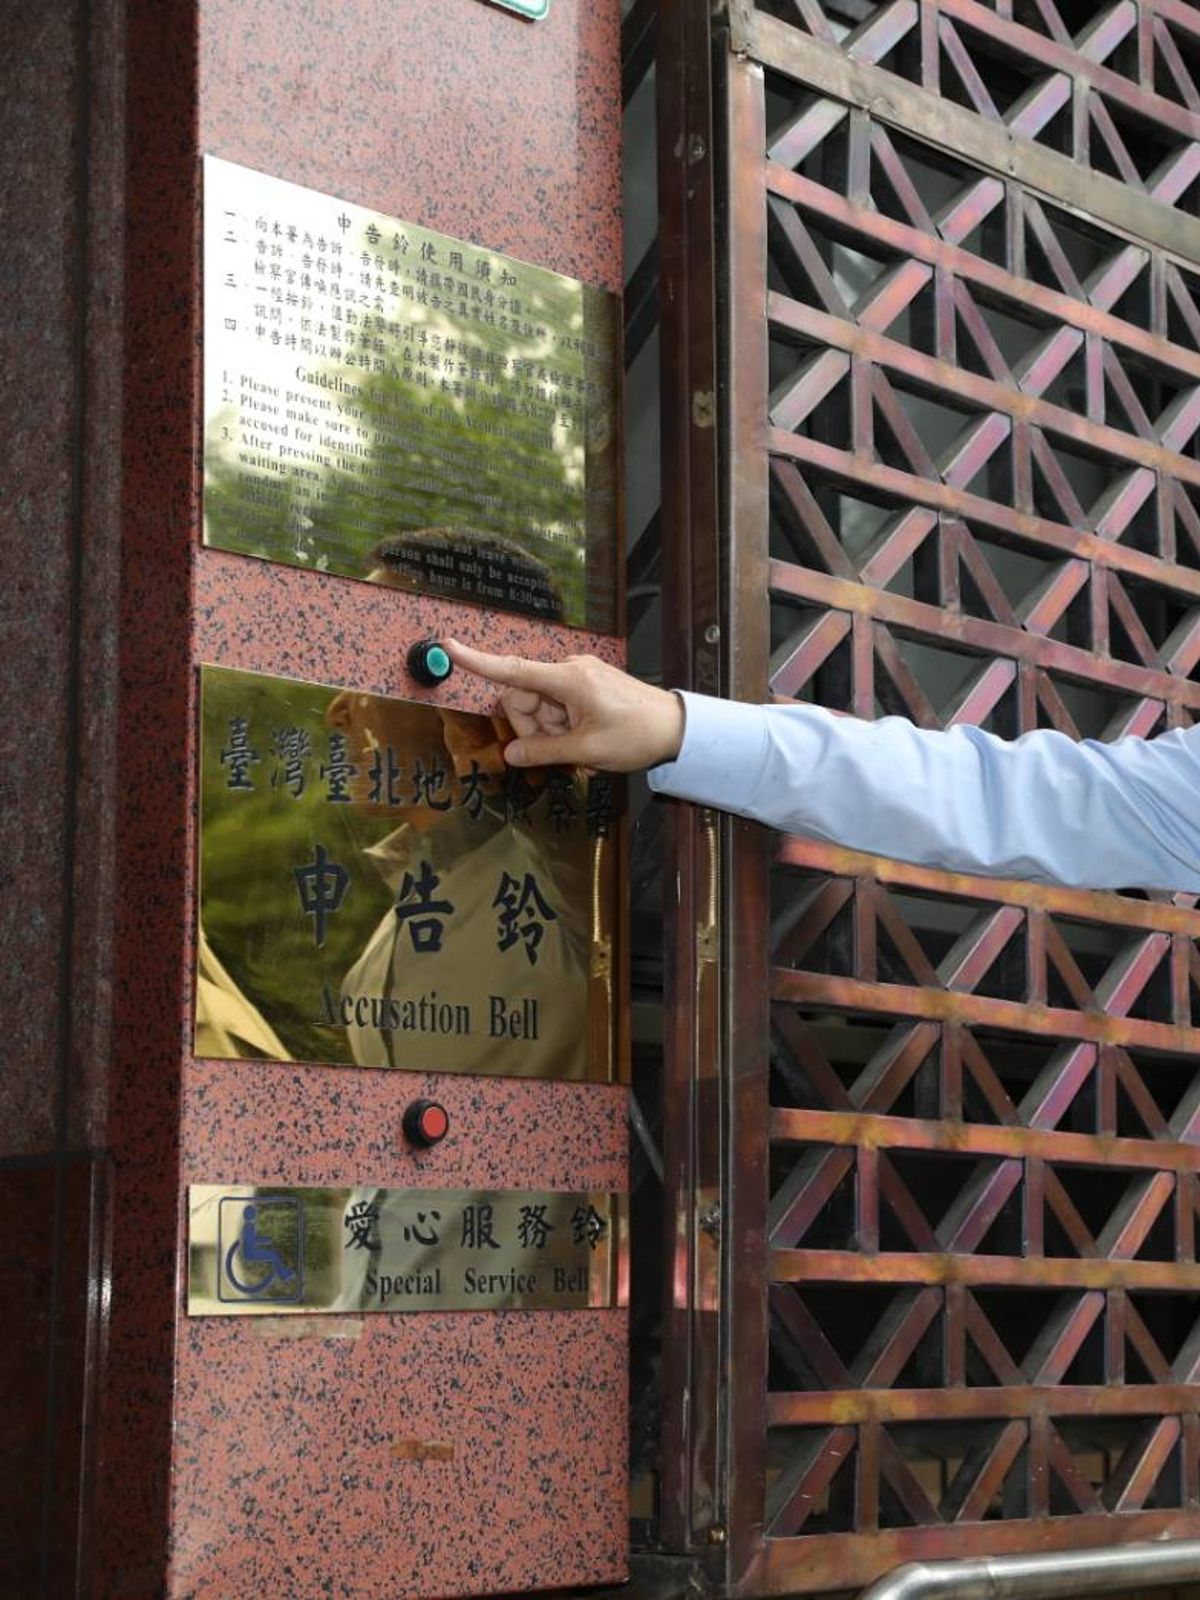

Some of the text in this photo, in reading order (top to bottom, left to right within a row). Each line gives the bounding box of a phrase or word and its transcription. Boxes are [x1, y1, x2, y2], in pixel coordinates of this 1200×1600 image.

[337, 211, 517, 292] 申告鈴使用須知
[221, 370, 233, 386] 1.
[239, 375, 279, 398] Please
[286, 388, 331, 414] present
[337, 401, 364, 423] your
[295, 365, 364, 398] Guidelines
[221, 388, 233, 404] 2.
[239, 393, 279, 416] Please
[286, 405, 319, 426] make
[324, 418, 350, 435] sure
[356, 424, 369, 439] to
[239, 411, 288, 437] accused
[294, 426, 312, 443] for
[220, 426, 233, 442] 3.
[240, 430, 272, 452] After
[278, 442, 331, 469] pressing
[336, 455, 357, 473] the
[239, 450, 286, 476] waiting
[291, 465, 324, 482] area.
[426, 550, 453, 570] shall
[459, 558, 483, 579] only
[488, 565, 502, 581] be
[429, 568, 457, 587] hour
[461, 575, 471, 591] is
[476, 578, 503, 598] from
[220, 716, 620, 838] 臺灣臺北地方檢察署
[293, 844, 557, 966] 申告鈴
[316, 986, 540, 1040] Accusation Bell
[344, 1200, 607, 1251] 愛心服務鈴
[367, 1266, 589, 1302] Special Service Bell
